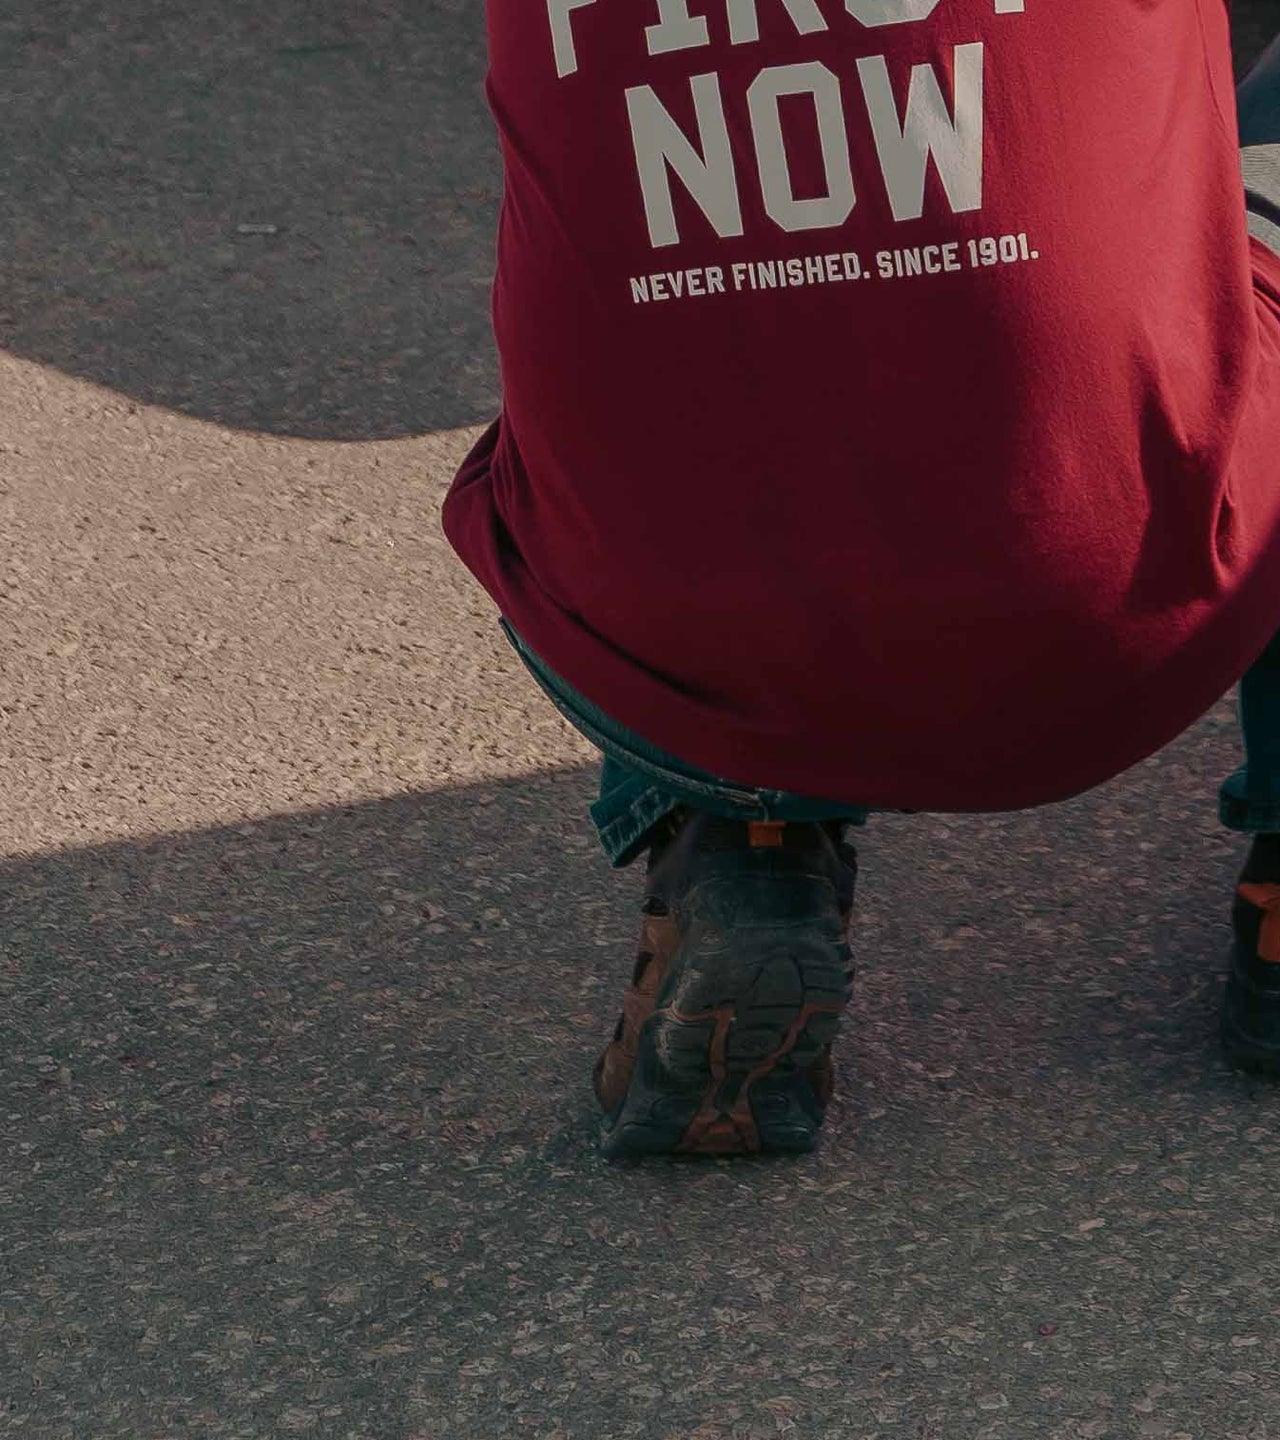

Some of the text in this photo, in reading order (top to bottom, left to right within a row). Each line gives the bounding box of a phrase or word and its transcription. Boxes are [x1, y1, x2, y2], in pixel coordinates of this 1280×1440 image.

[625, 42, 983, 249] NOW
[629, 233, 1039, 303] NEVER FINISHED. SINCE 1901.
